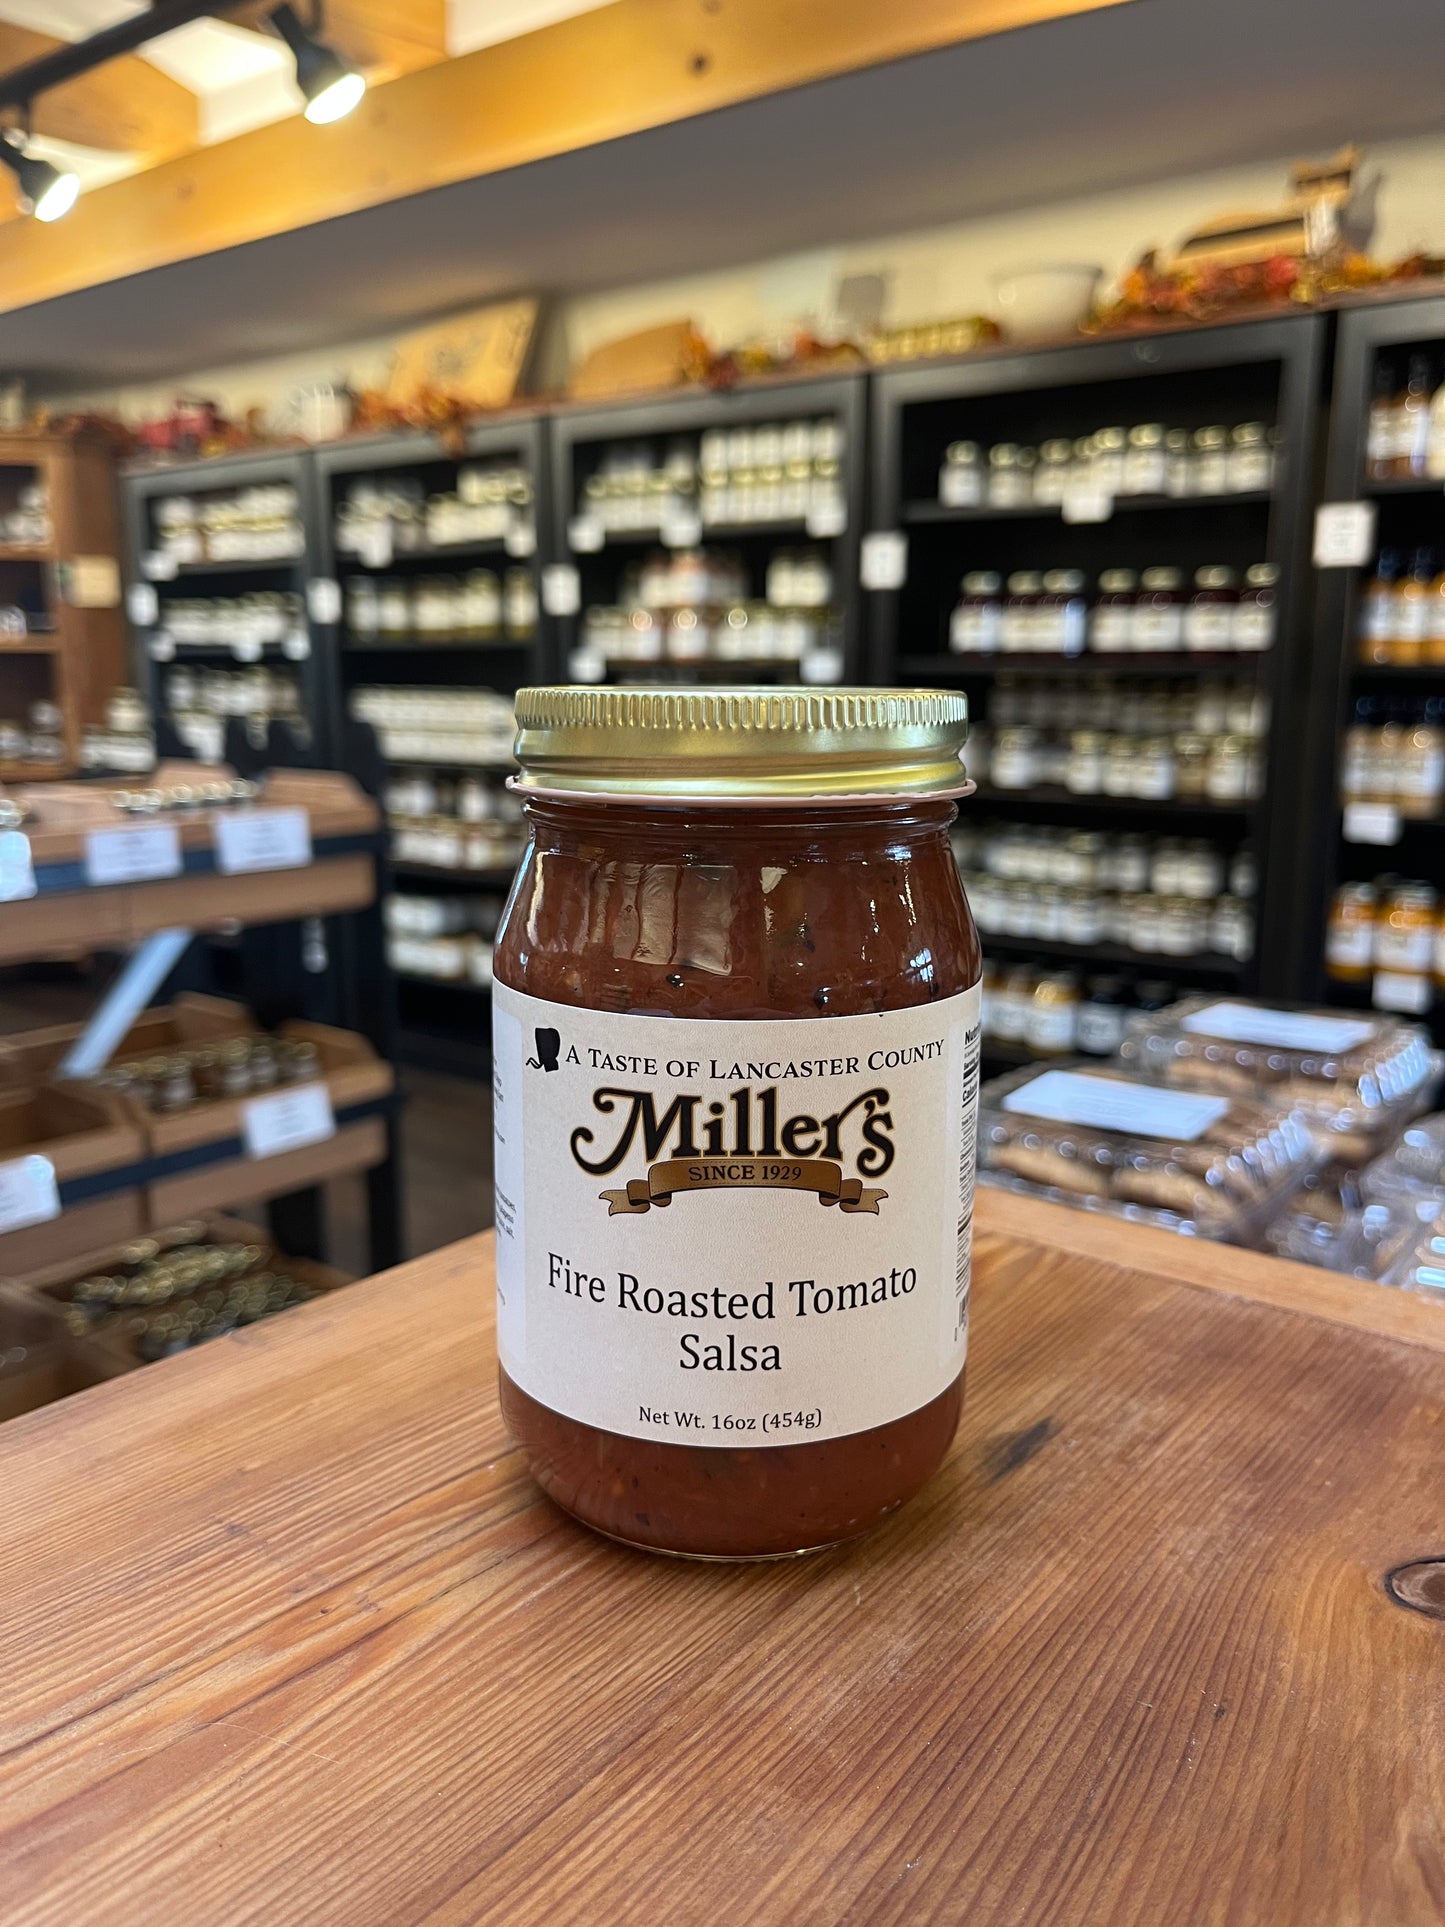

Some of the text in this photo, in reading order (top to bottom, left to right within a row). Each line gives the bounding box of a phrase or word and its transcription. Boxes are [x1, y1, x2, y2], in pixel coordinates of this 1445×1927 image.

[565, 1044, 581, 1065] A
[588, 1047, 658, 1076] TASTE
[665, 1059, 701, 1078] OF
[709, 1056, 860, 1080] LANCASTER
[867, 1038, 945, 1071] COUNTY
[570, 1087, 895, 1178] Miller's
[688, 1165, 802, 1182] SINCE 1929
[548, 1251, 917, 1320] Fire Roasted Tomato
[679, 1333, 783, 1372] Salsa
[639, 1405, 822, 1434] Net Wt. 16oz (454g)
